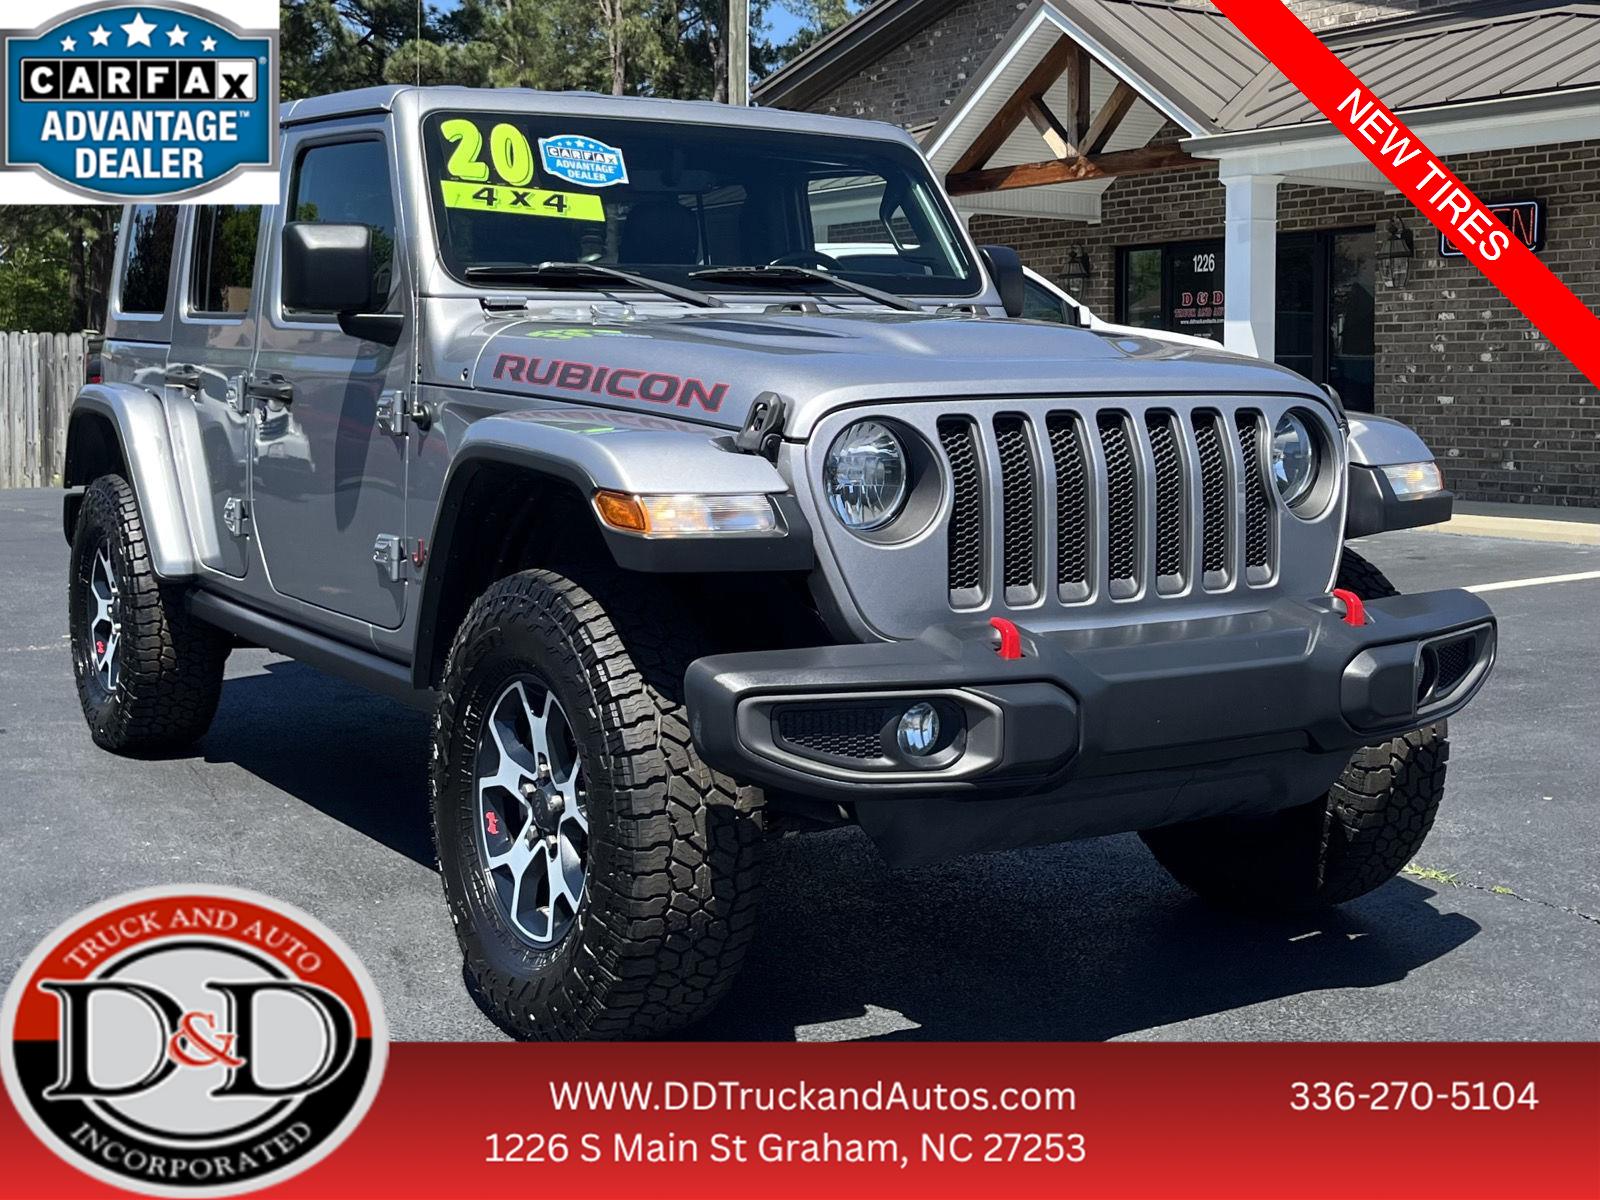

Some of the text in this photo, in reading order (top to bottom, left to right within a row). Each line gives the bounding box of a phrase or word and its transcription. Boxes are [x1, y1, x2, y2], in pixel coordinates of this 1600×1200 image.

[440, 118, 535, 187] 20
[548, 146, 618, 165] CARFAX
[567, 169, 608, 182] DEALER
[1193, 253, 1215, 272] 1226
[492, 353, 731, 413] RUBICON
